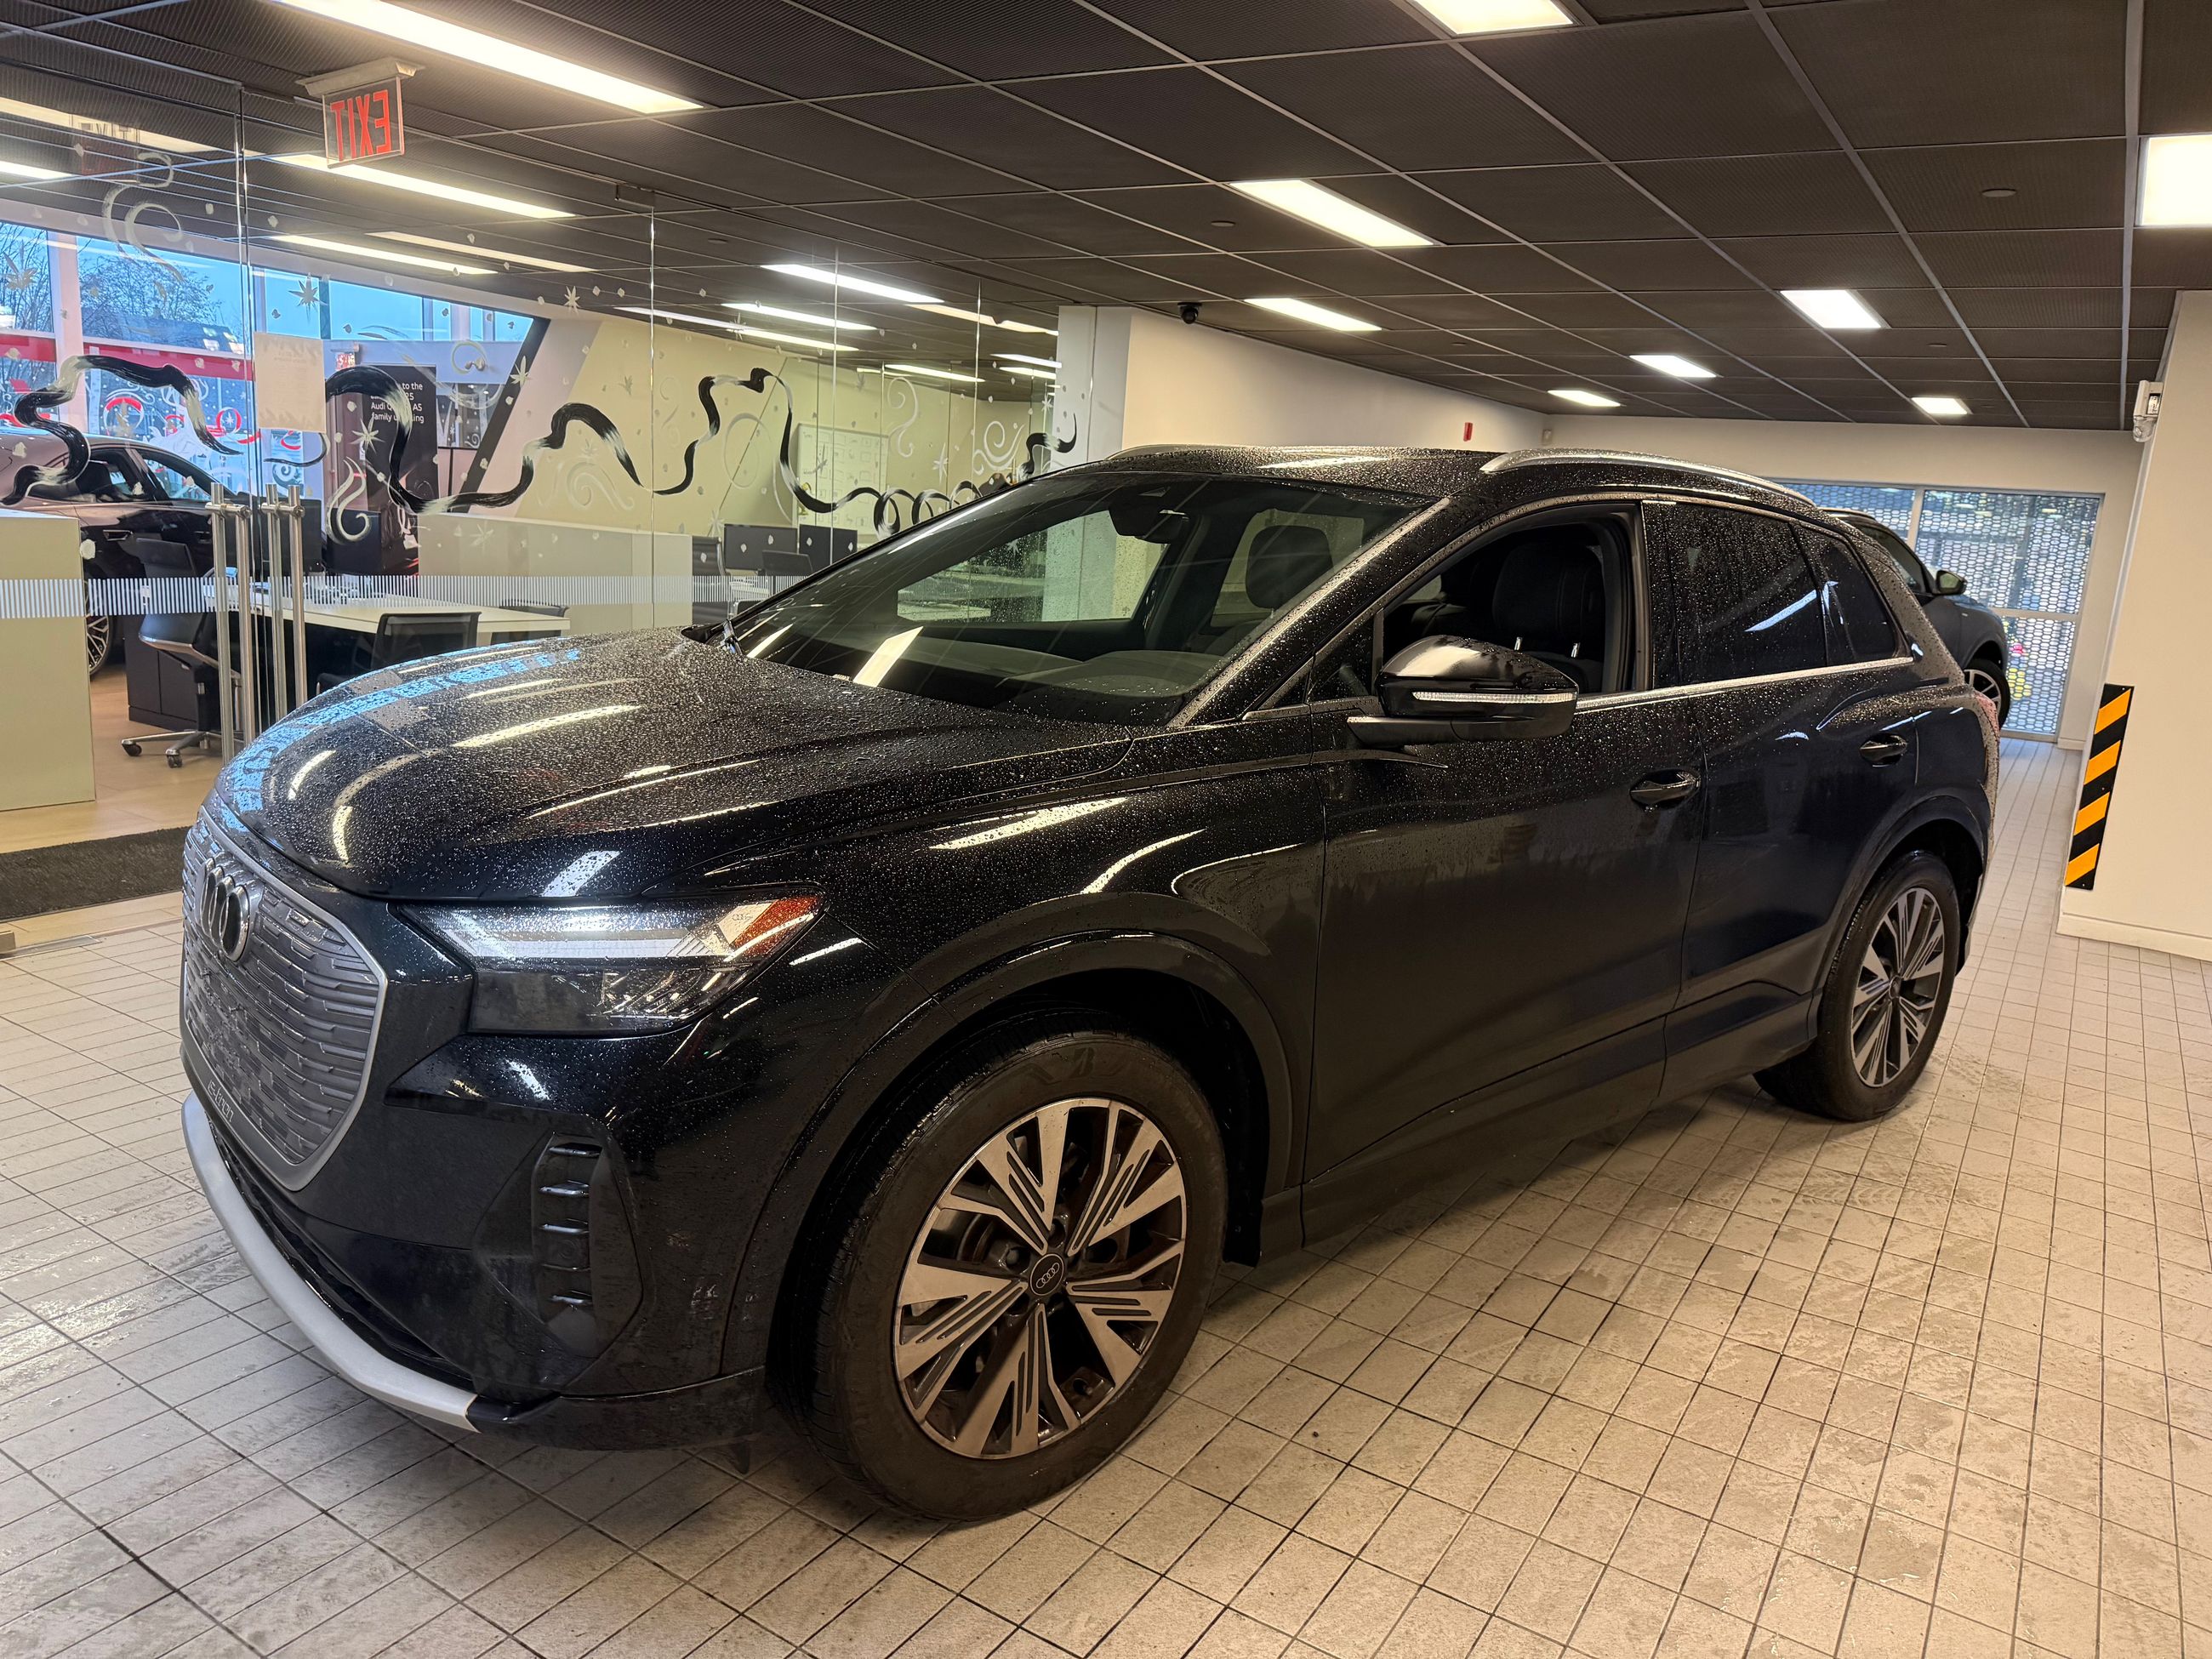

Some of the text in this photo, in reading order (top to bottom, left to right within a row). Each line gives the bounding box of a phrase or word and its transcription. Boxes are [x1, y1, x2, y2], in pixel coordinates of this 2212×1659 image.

[411, 382, 423, 391] the
[371, 402, 385, 410] Audi
[372, 412, 392, 422] family
